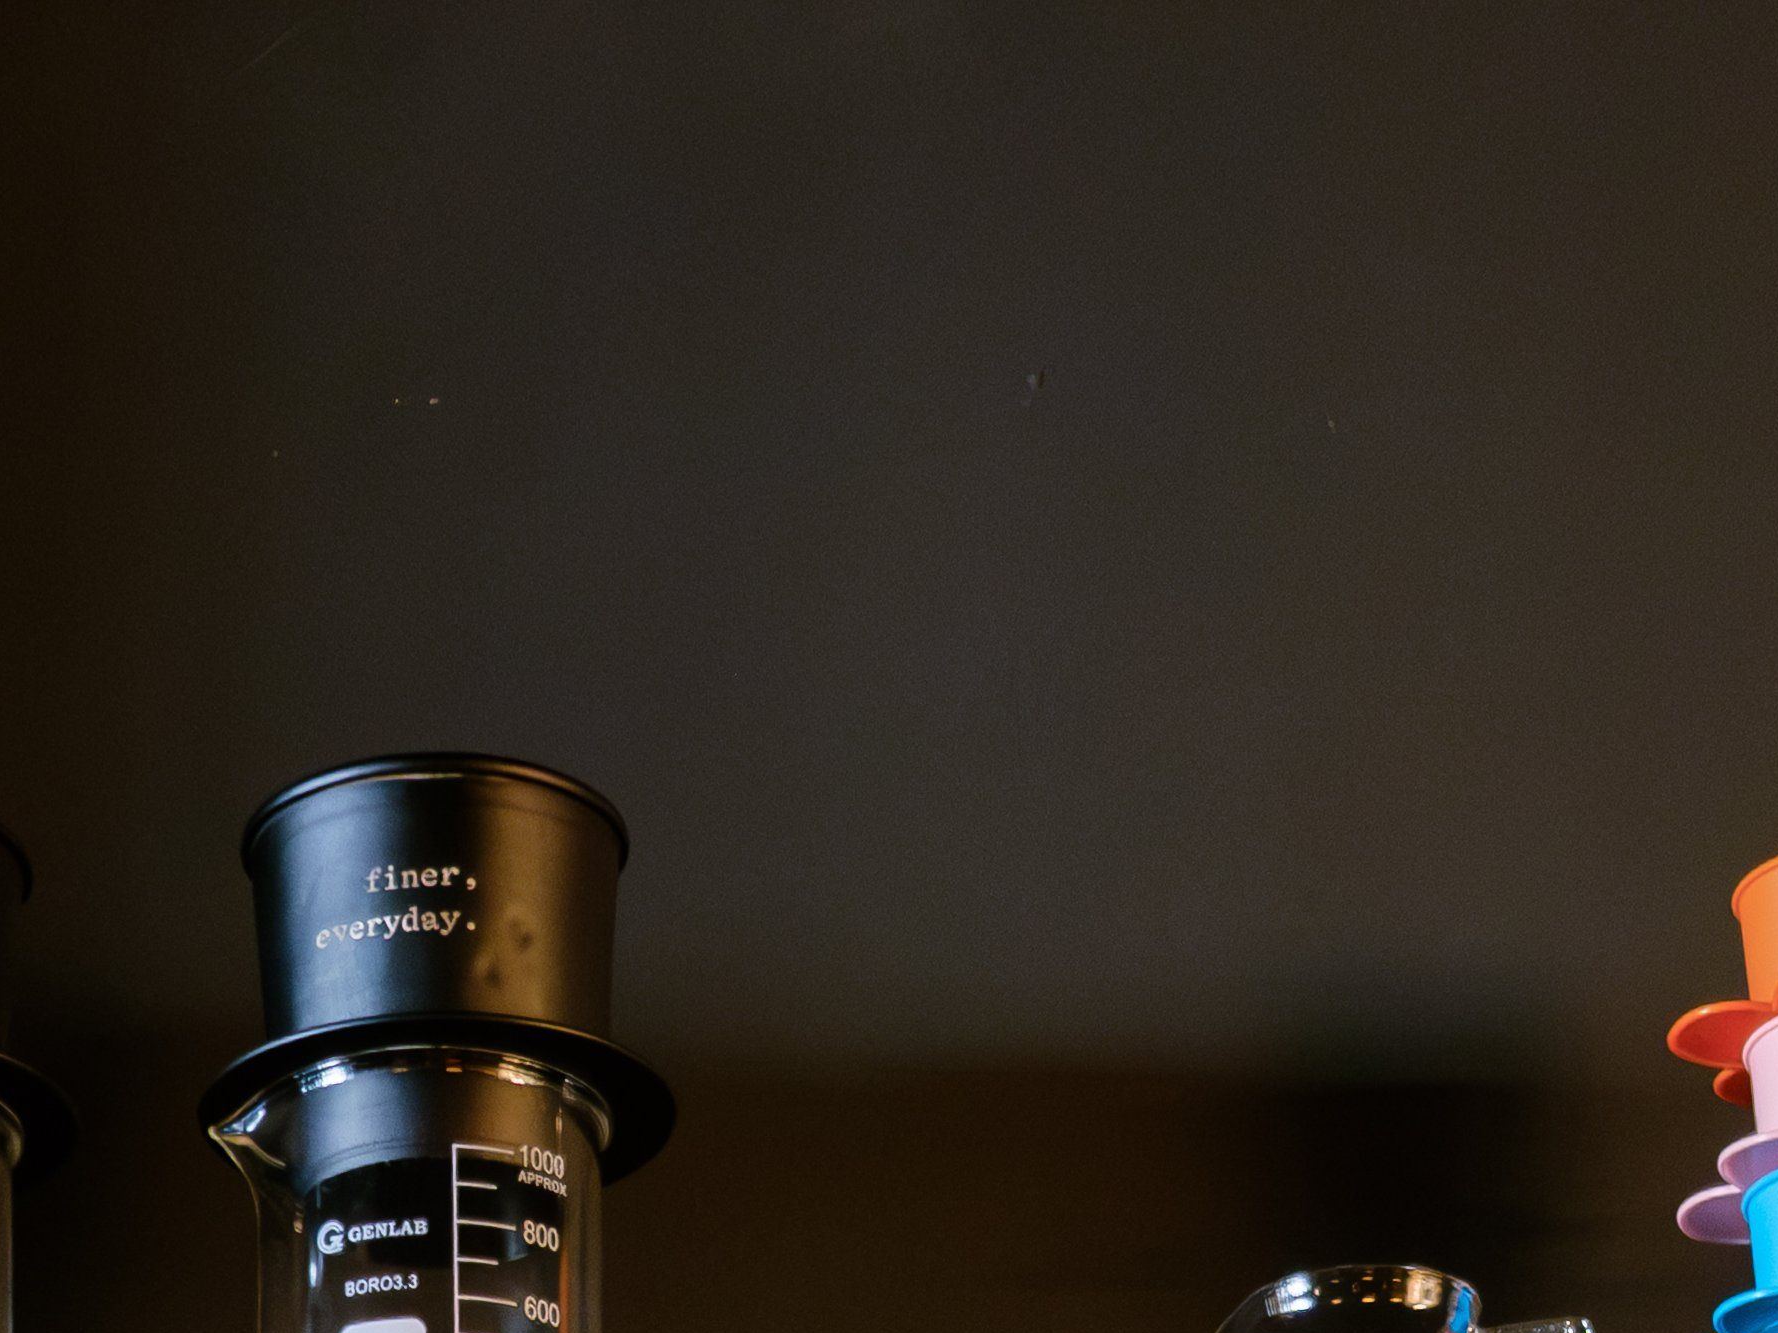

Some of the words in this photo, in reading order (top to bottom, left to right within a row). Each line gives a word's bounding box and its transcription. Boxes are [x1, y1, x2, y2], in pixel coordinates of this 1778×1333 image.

[364, 863, 477, 893] finer,
[314, 906, 477, 950] everyday.
[519, 1145, 564, 1179] 1000
[518, 1169, 567, 1197] APPROX
[347, 1218, 429, 1242] GENLAB
[523, 1220, 559, 1252] 800
[524, 1296, 560, 1327] 600
